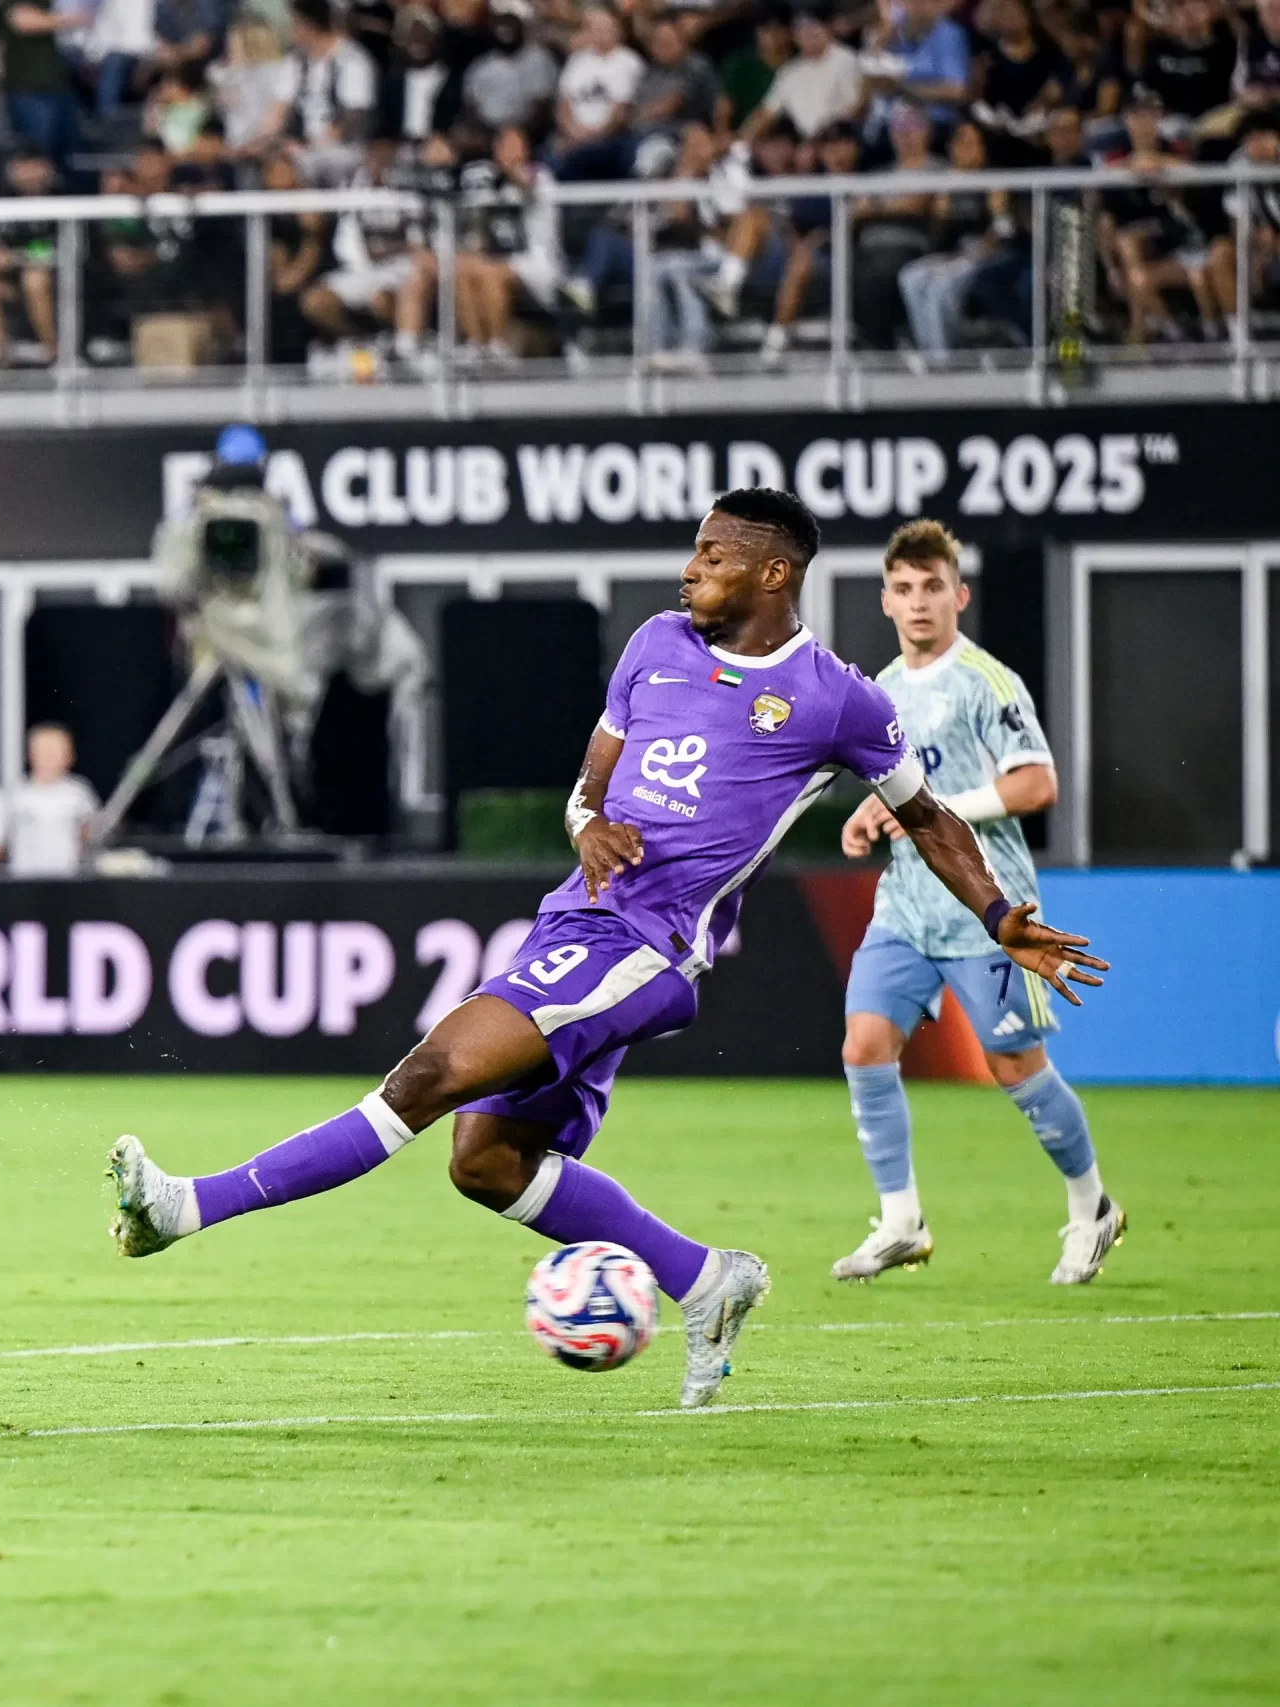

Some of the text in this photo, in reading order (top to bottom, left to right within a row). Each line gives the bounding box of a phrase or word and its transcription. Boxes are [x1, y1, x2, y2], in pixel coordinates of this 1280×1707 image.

[322, 446, 509, 526] CLUB
[795, 437, 947, 519] CUP
[632, 785, 697, 818] etisalat and
[167, 918, 396, 1037] CUP
[528, 943, 589, 985] 9
[989, 960, 1012, 1006] 7
